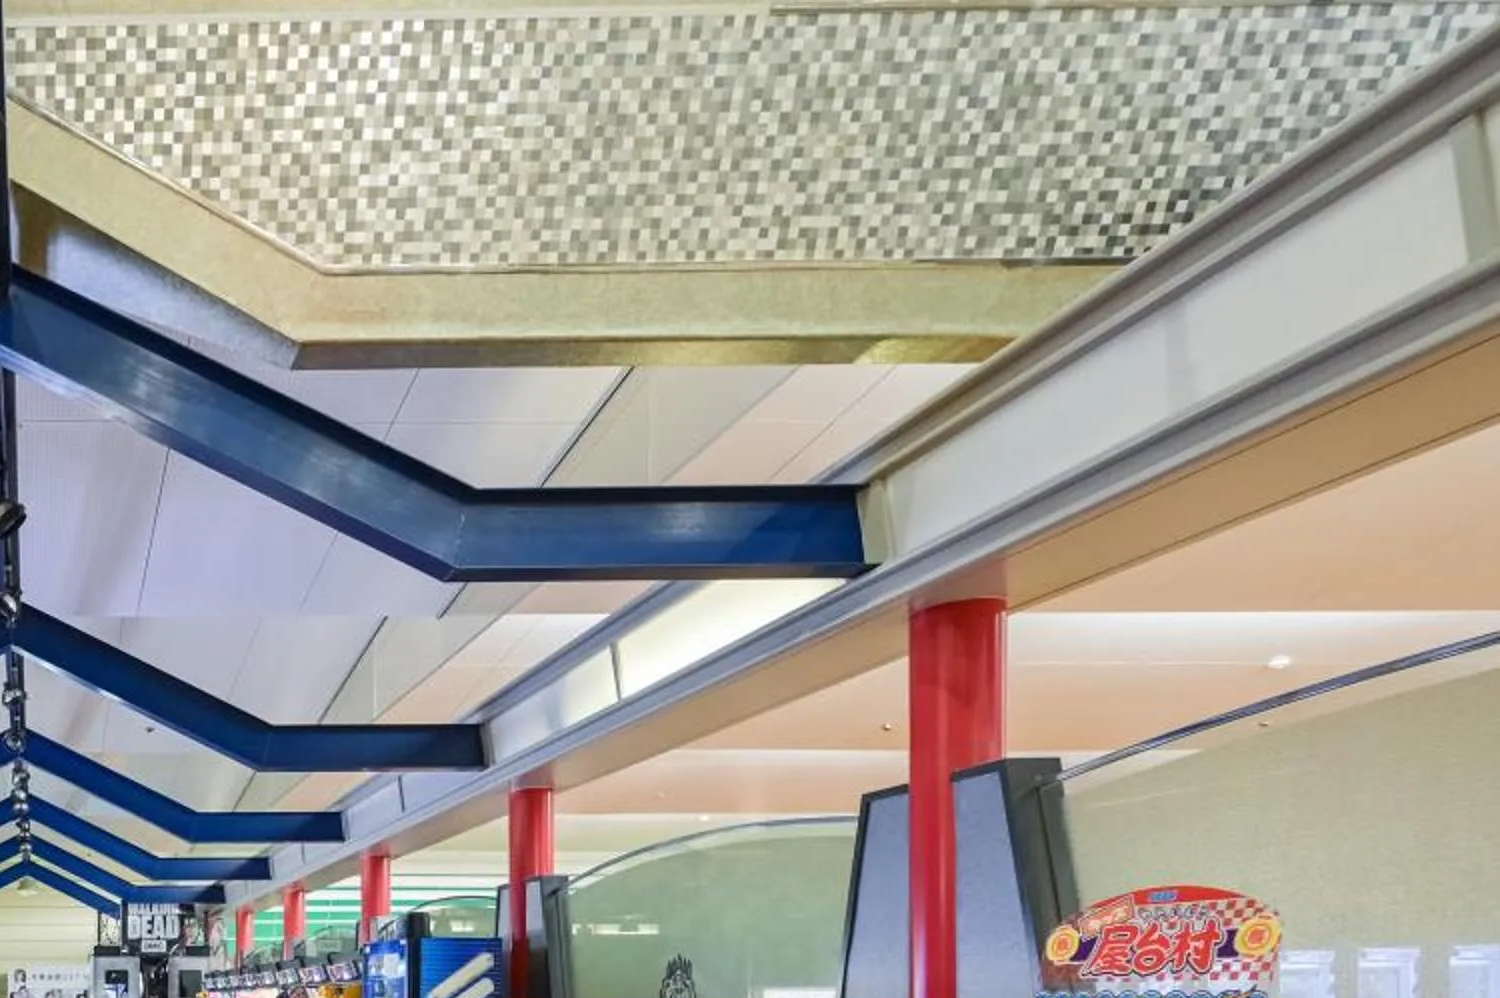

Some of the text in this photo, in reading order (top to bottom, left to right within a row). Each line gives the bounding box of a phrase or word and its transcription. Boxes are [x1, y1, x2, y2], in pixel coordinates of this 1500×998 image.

[127, 915, 180, 940] DEAD
[1080, 917, 1222, 977] 屋台村
